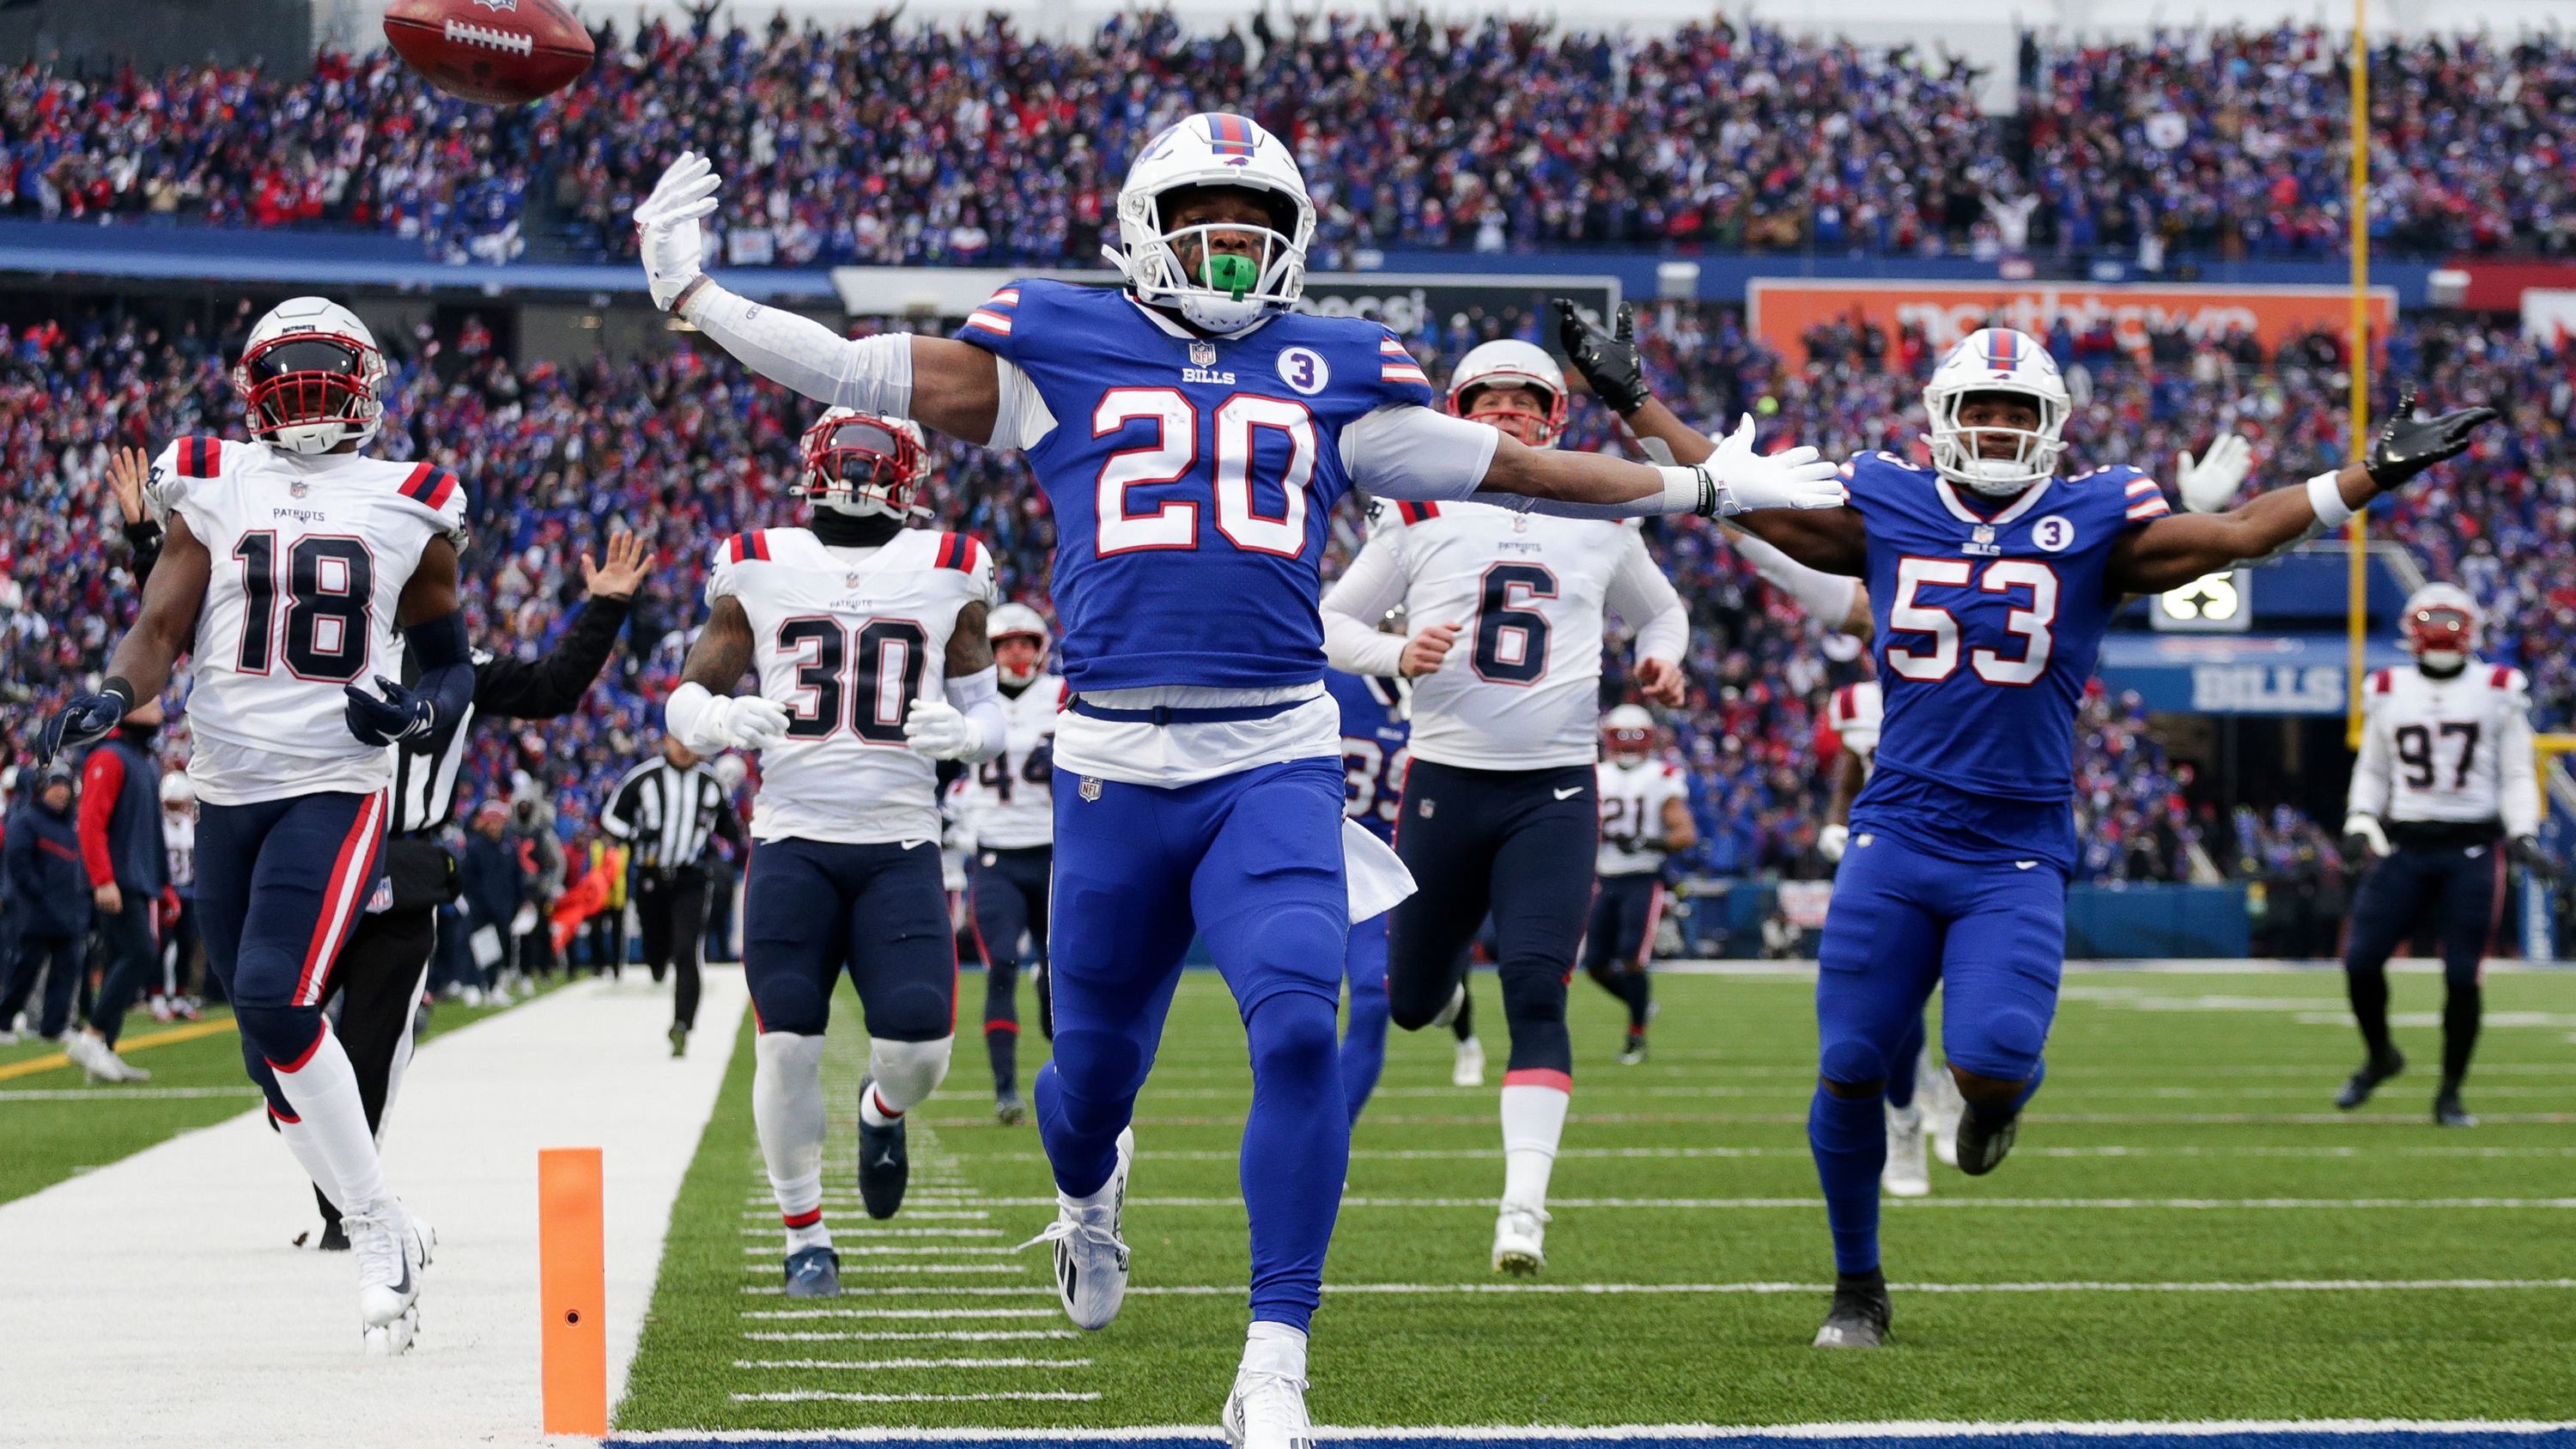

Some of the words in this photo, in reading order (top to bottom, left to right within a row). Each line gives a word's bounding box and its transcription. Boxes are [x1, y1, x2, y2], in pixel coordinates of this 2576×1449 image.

[1182, 367, 1236, 385] BILLS
[1194, 352, 1213, 362] NFL
[1291, 353, 1315, 389] 3
[1091, 386, 1318, 560] 20
[273, 507, 325, 522] PATRIOTS
[2044, 521, 2061, 546] 3
[233, 529, 375, 684] 18
[1470, 561, 1559, 687] 6
[1886, 555, 2061, 685] 53
[776, 615, 929, 748] 30
[2191, 666, 2344, 712] BILLS
[2396, 719, 2481, 791] 97
[1082, 782, 1100, 797] NFL
[1601, 797, 1644, 840] 21
